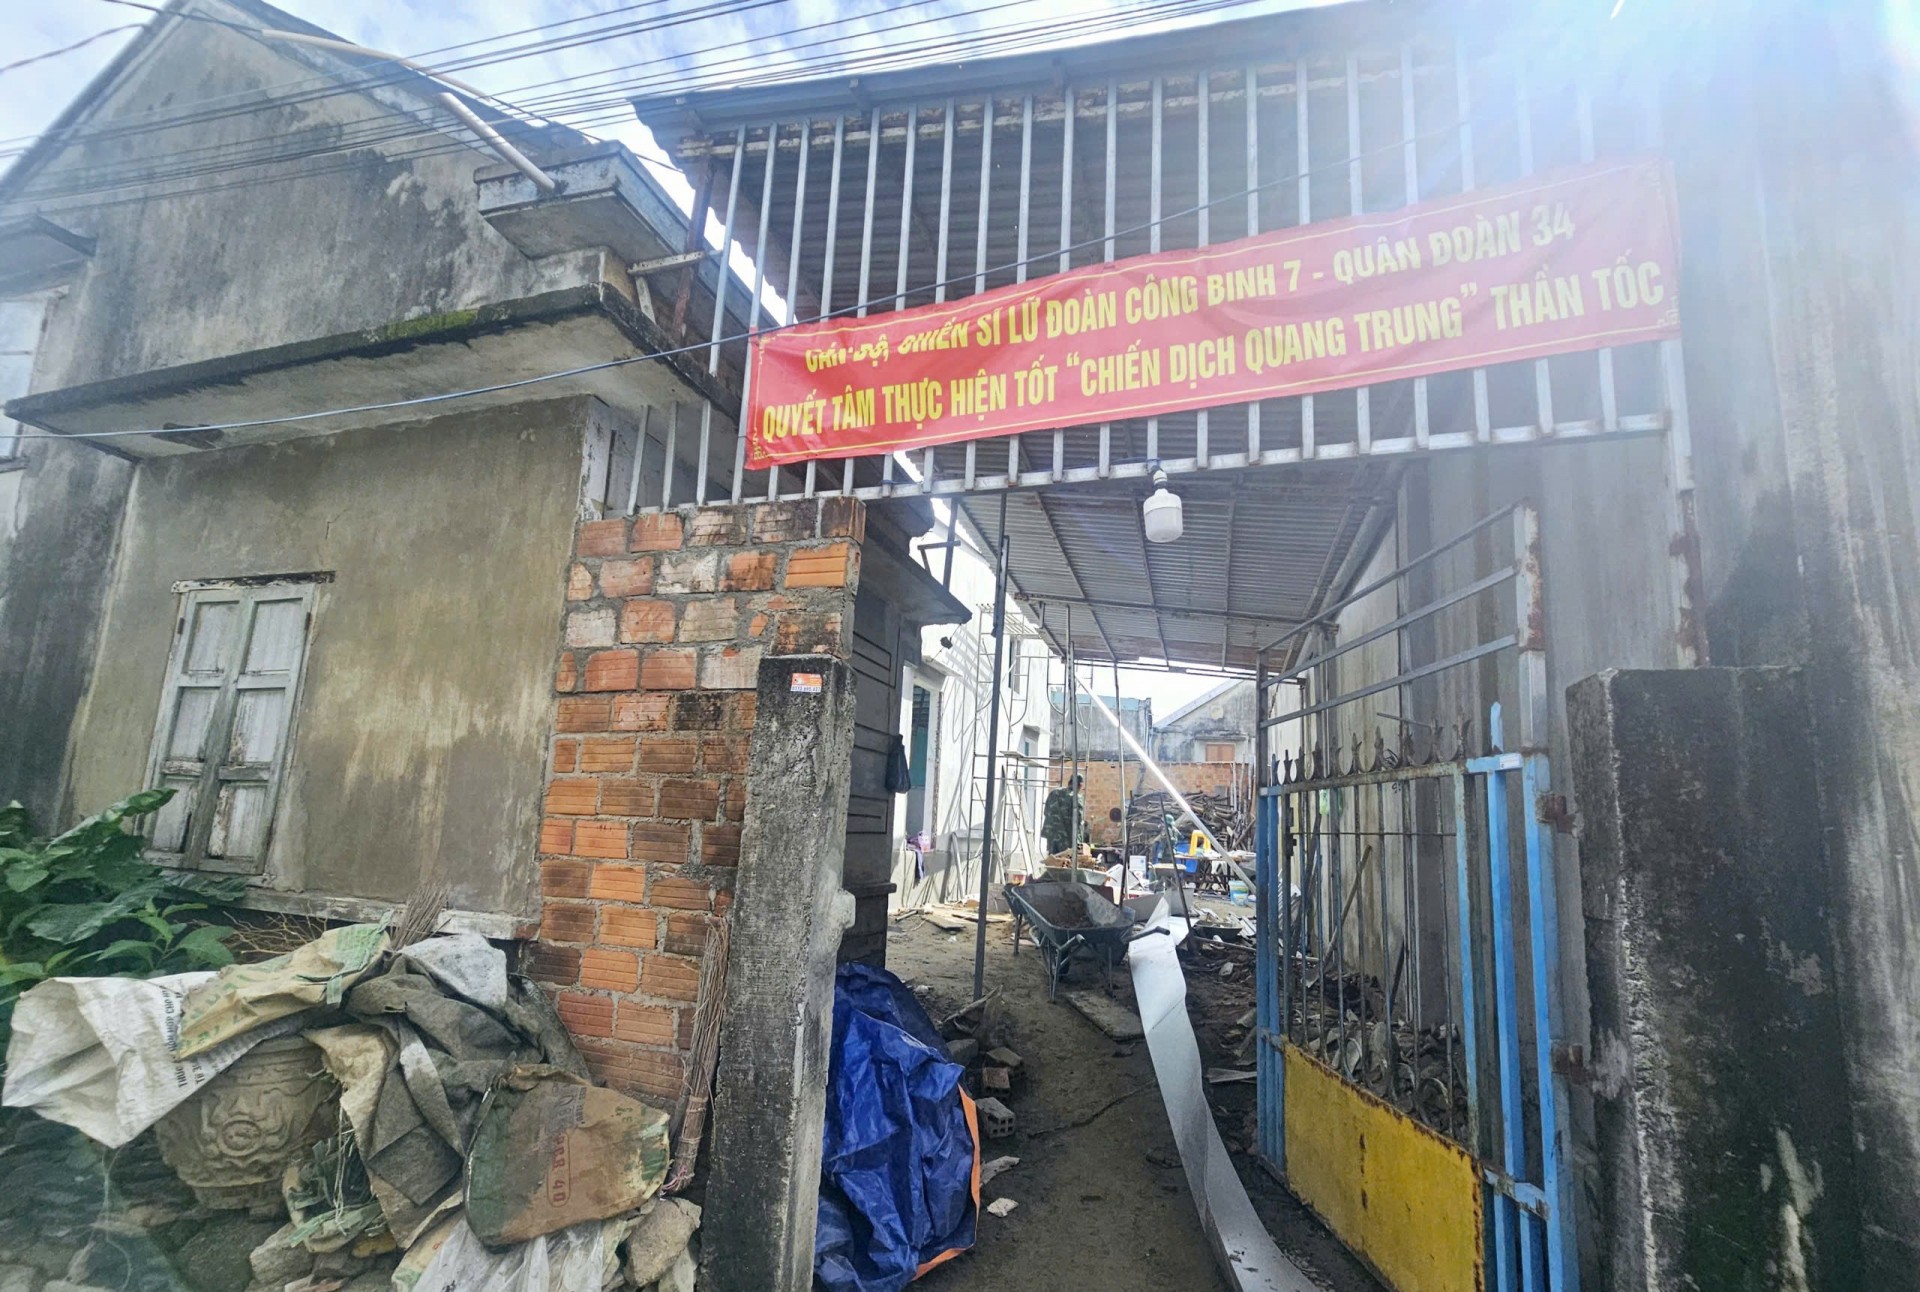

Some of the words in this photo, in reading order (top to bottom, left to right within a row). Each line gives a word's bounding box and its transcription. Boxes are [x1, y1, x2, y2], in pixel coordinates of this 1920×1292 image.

[762, 388, 827, 443] QUYẾT
[832, 384, 876, 432] TÂM
[881, 377, 943, 430] THỰC
[951, 368, 1007, 422] HIỆN
[1014, 354, 1058, 407] TỐT
[1169, 335, 1236, 390] DỊCH
[1244, 316, 1347, 375] QUANG
[1489, 263, 1585, 331] THẦN
[1591, 248, 1665, 312] TỐC
[1045, 287, 1117, 339] ĐOÀN
[1124, 274, 1199, 325] CÔNG
[1206, 263, 1277, 307] BINH
[1283, 259, 1302, 292] 7
[1333, 235, 1422, 285] QUÂN
[1428, 213, 1522, 267] ĐOÀN
[1530, 202, 1577, 247] 34
